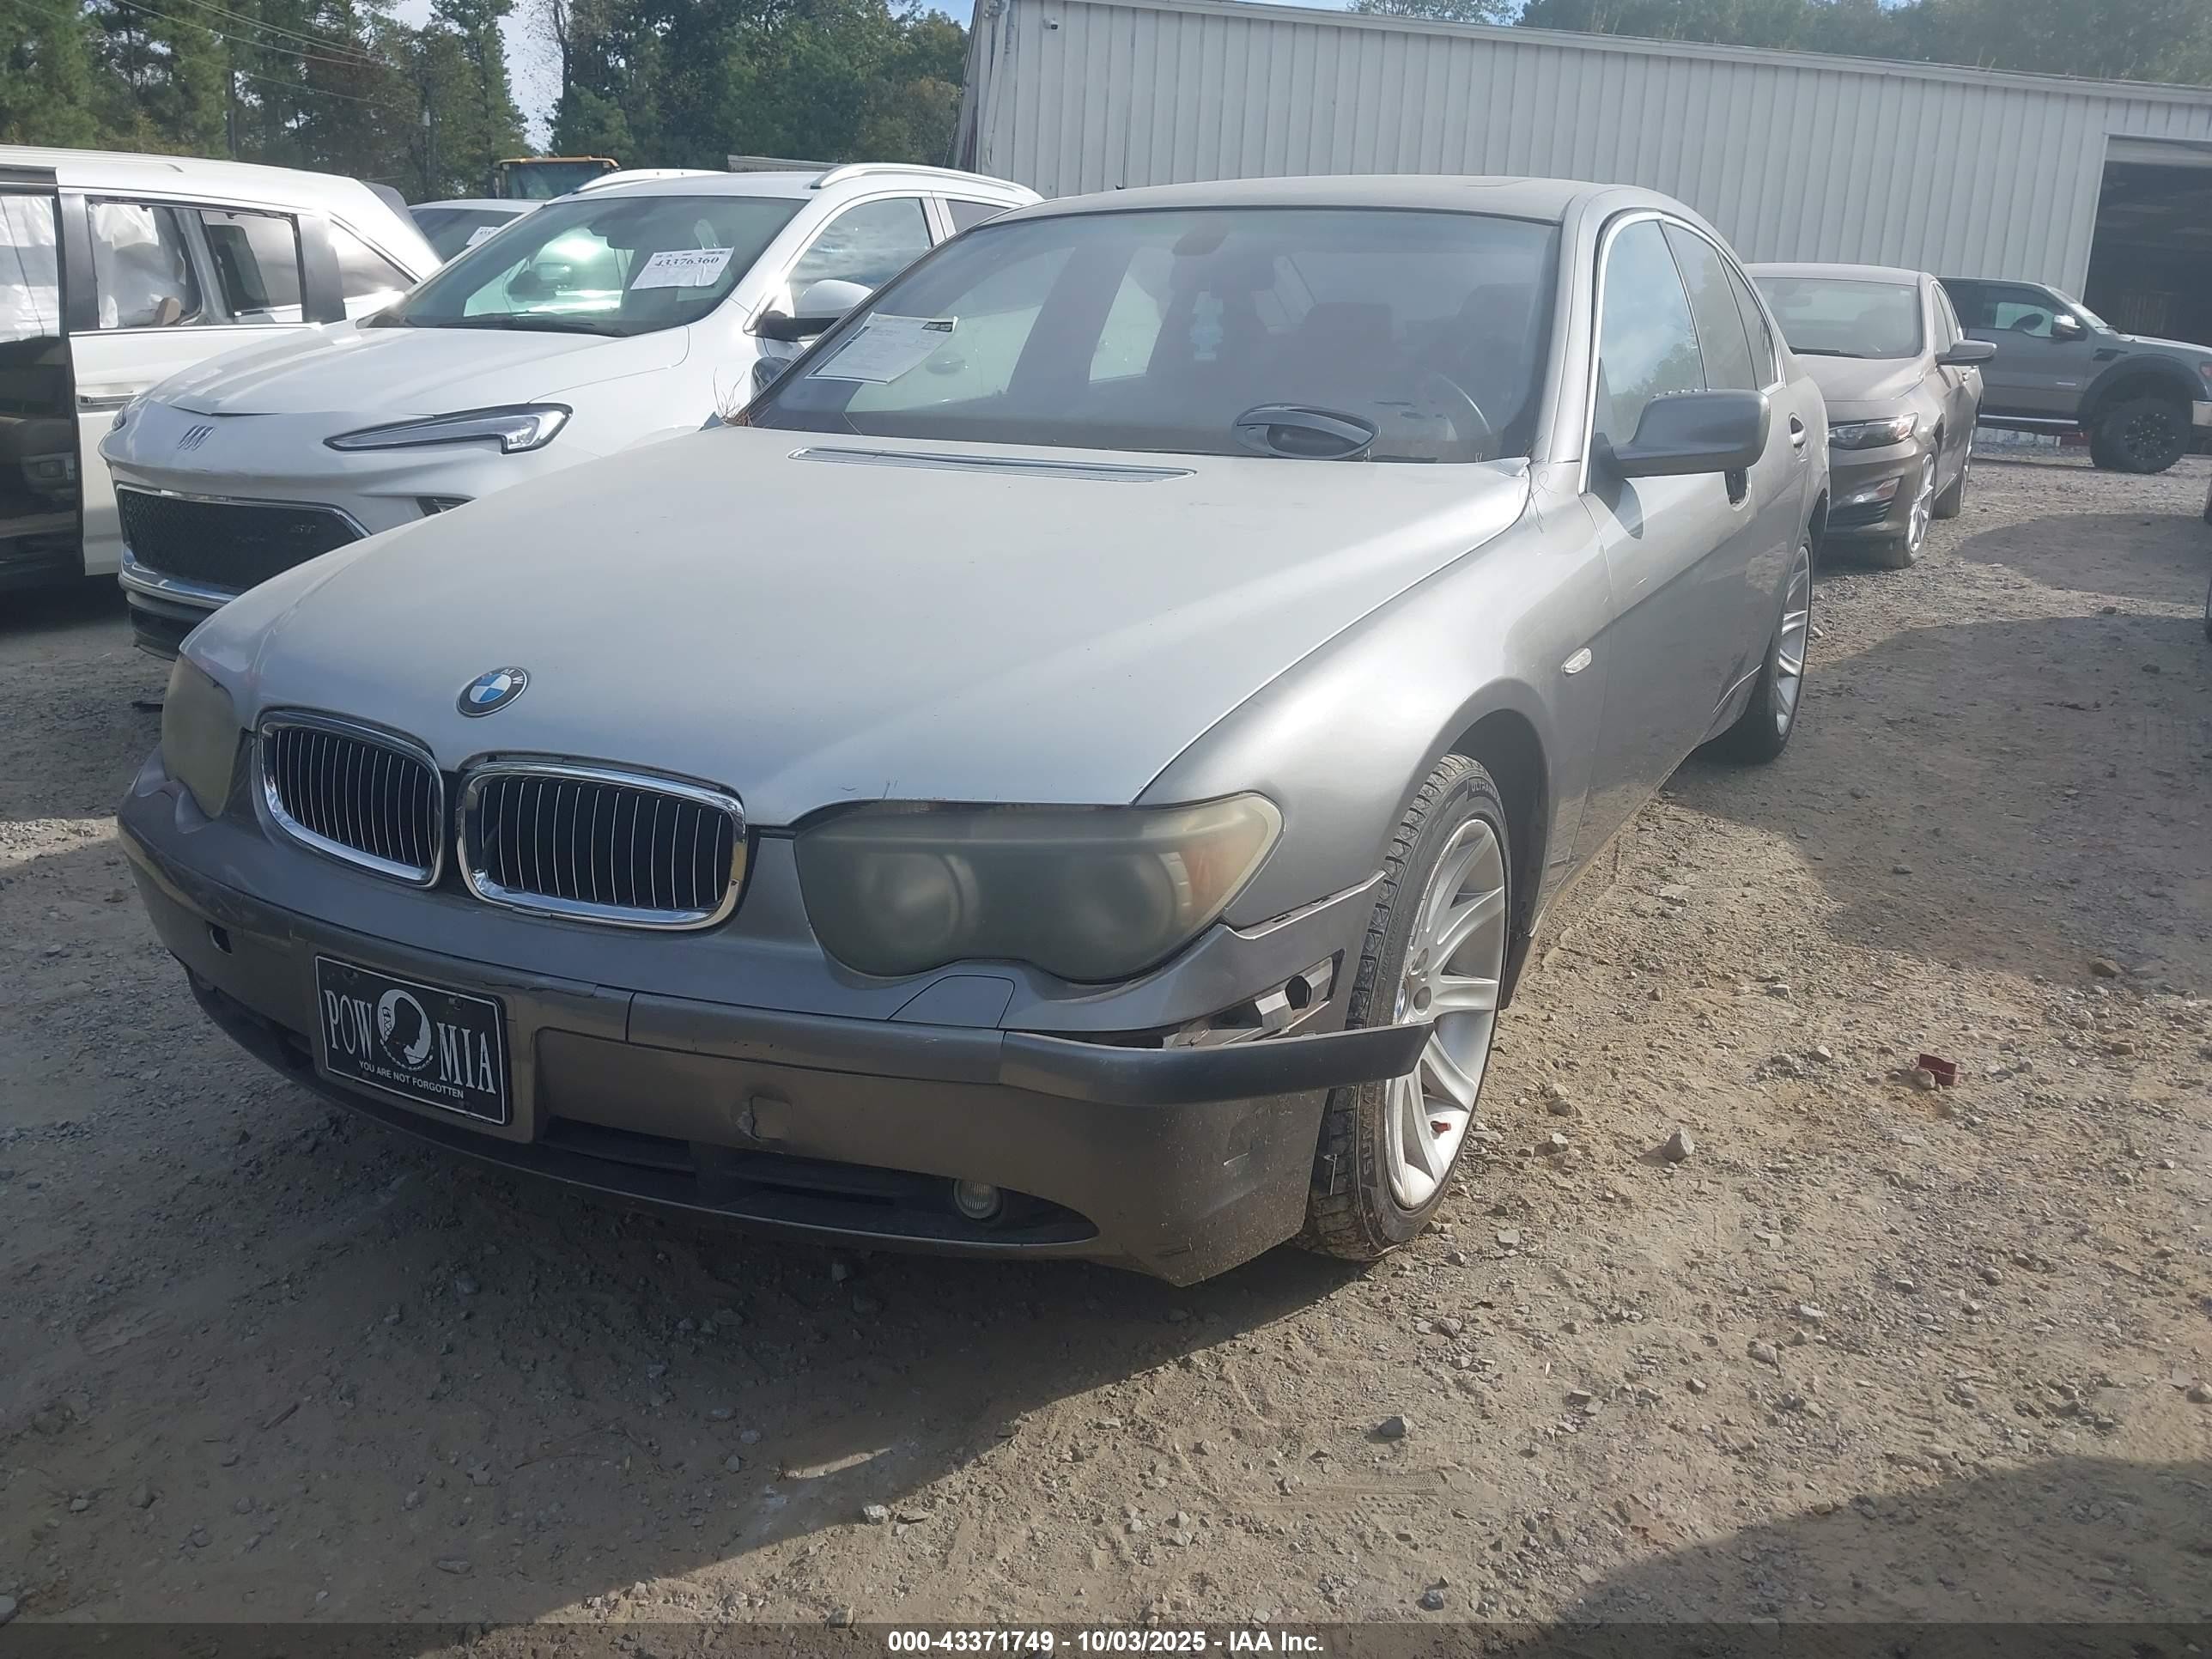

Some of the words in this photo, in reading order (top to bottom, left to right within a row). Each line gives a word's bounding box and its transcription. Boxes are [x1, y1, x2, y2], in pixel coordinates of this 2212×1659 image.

[654, 257, 719, 267] 43376360
[325, 989, 373, 1060] POW
[436, 1022, 496, 1095] MIA
[359, 1060, 374, 1073] YOU
[376, 1066, 392, 1079] ARE
[392, 1072, 410, 1086] NOT
[412, 1078, 464, 1099] FORGOTTEN
